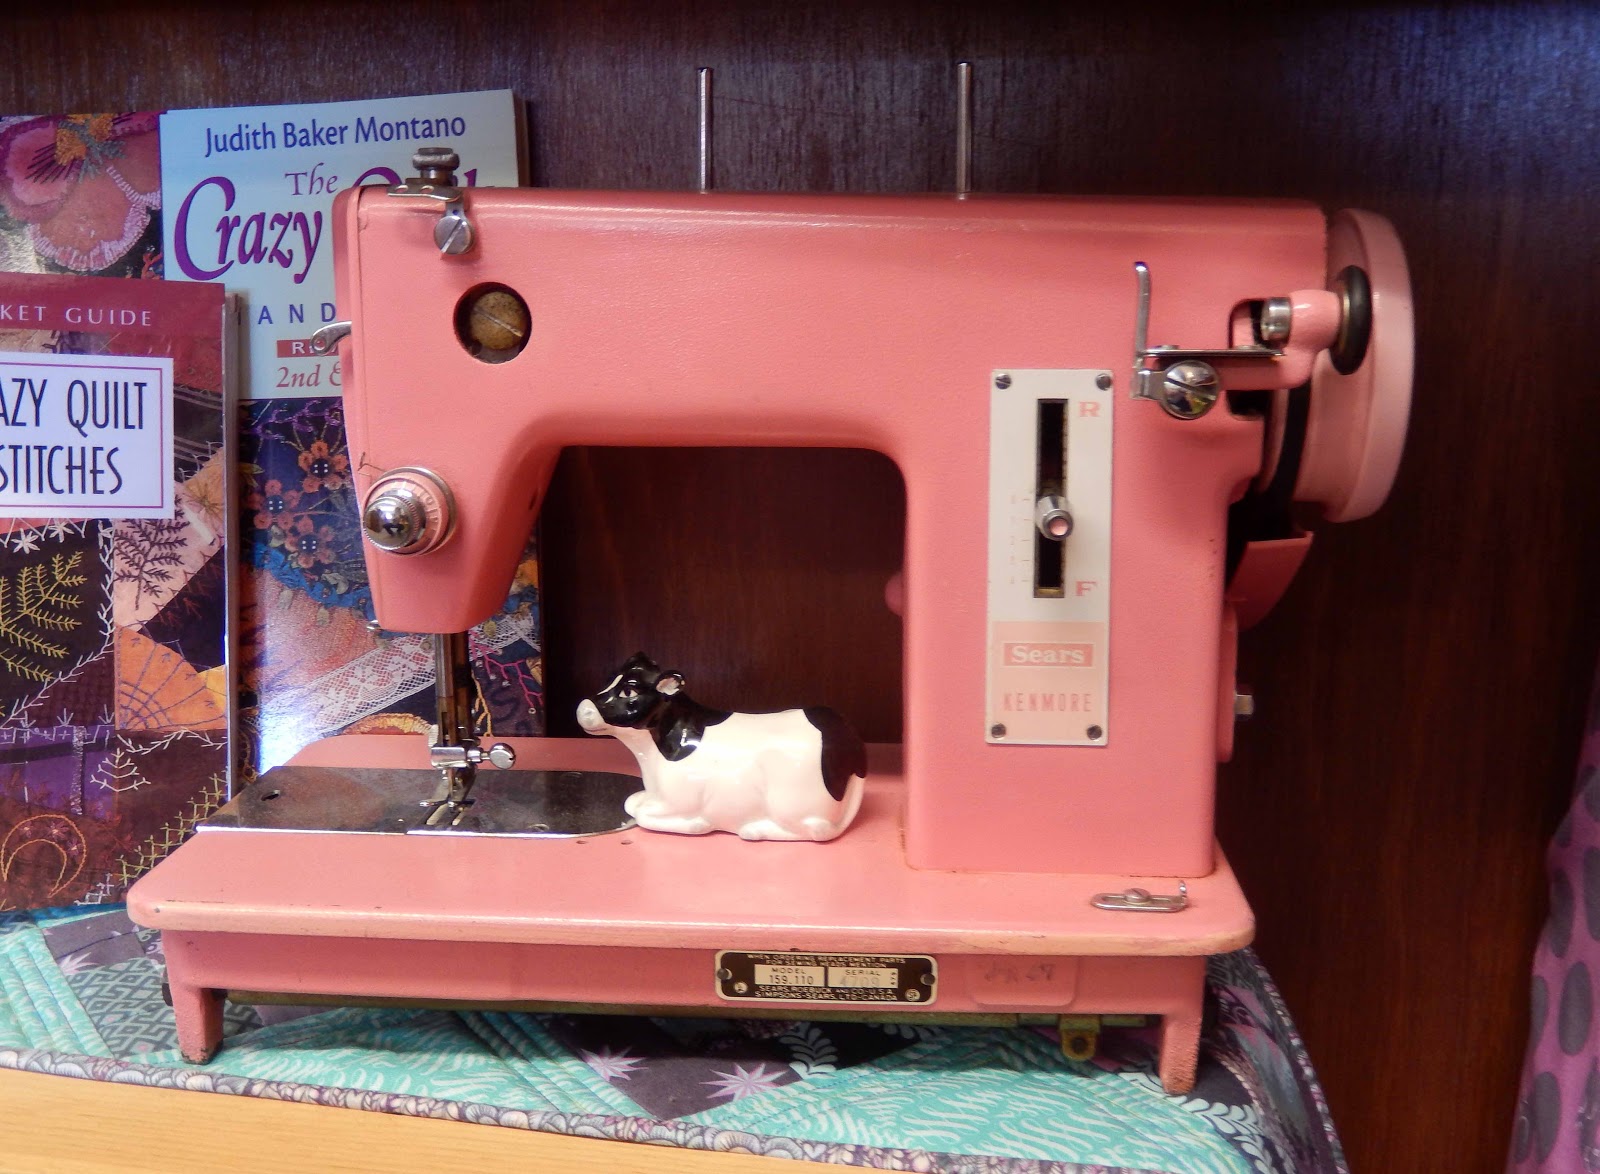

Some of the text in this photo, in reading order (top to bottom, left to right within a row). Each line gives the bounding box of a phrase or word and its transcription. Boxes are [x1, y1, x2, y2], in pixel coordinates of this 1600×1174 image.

[205, 115, 467, 158] Judith Baker Montano
[285, 162, 339, 197] The
[174, 176, 323, 284] Crazy
[0, 304, 152, 327] KET GUIDE
[257, 302, 337, 325] AND
[276, 363, 321, 388] 2nd
[66, 378, 148, 438] QUILT
[1078, 401, 1100, 417] R
[0, 444, 123, 495] STITCHES
[1075, 581, 1097, 597] F
[1011, 645, 1085, 664] Sears
[1003, 692, 1092, 712] KENMORE
[769, 974, 814, 985] 159.110
